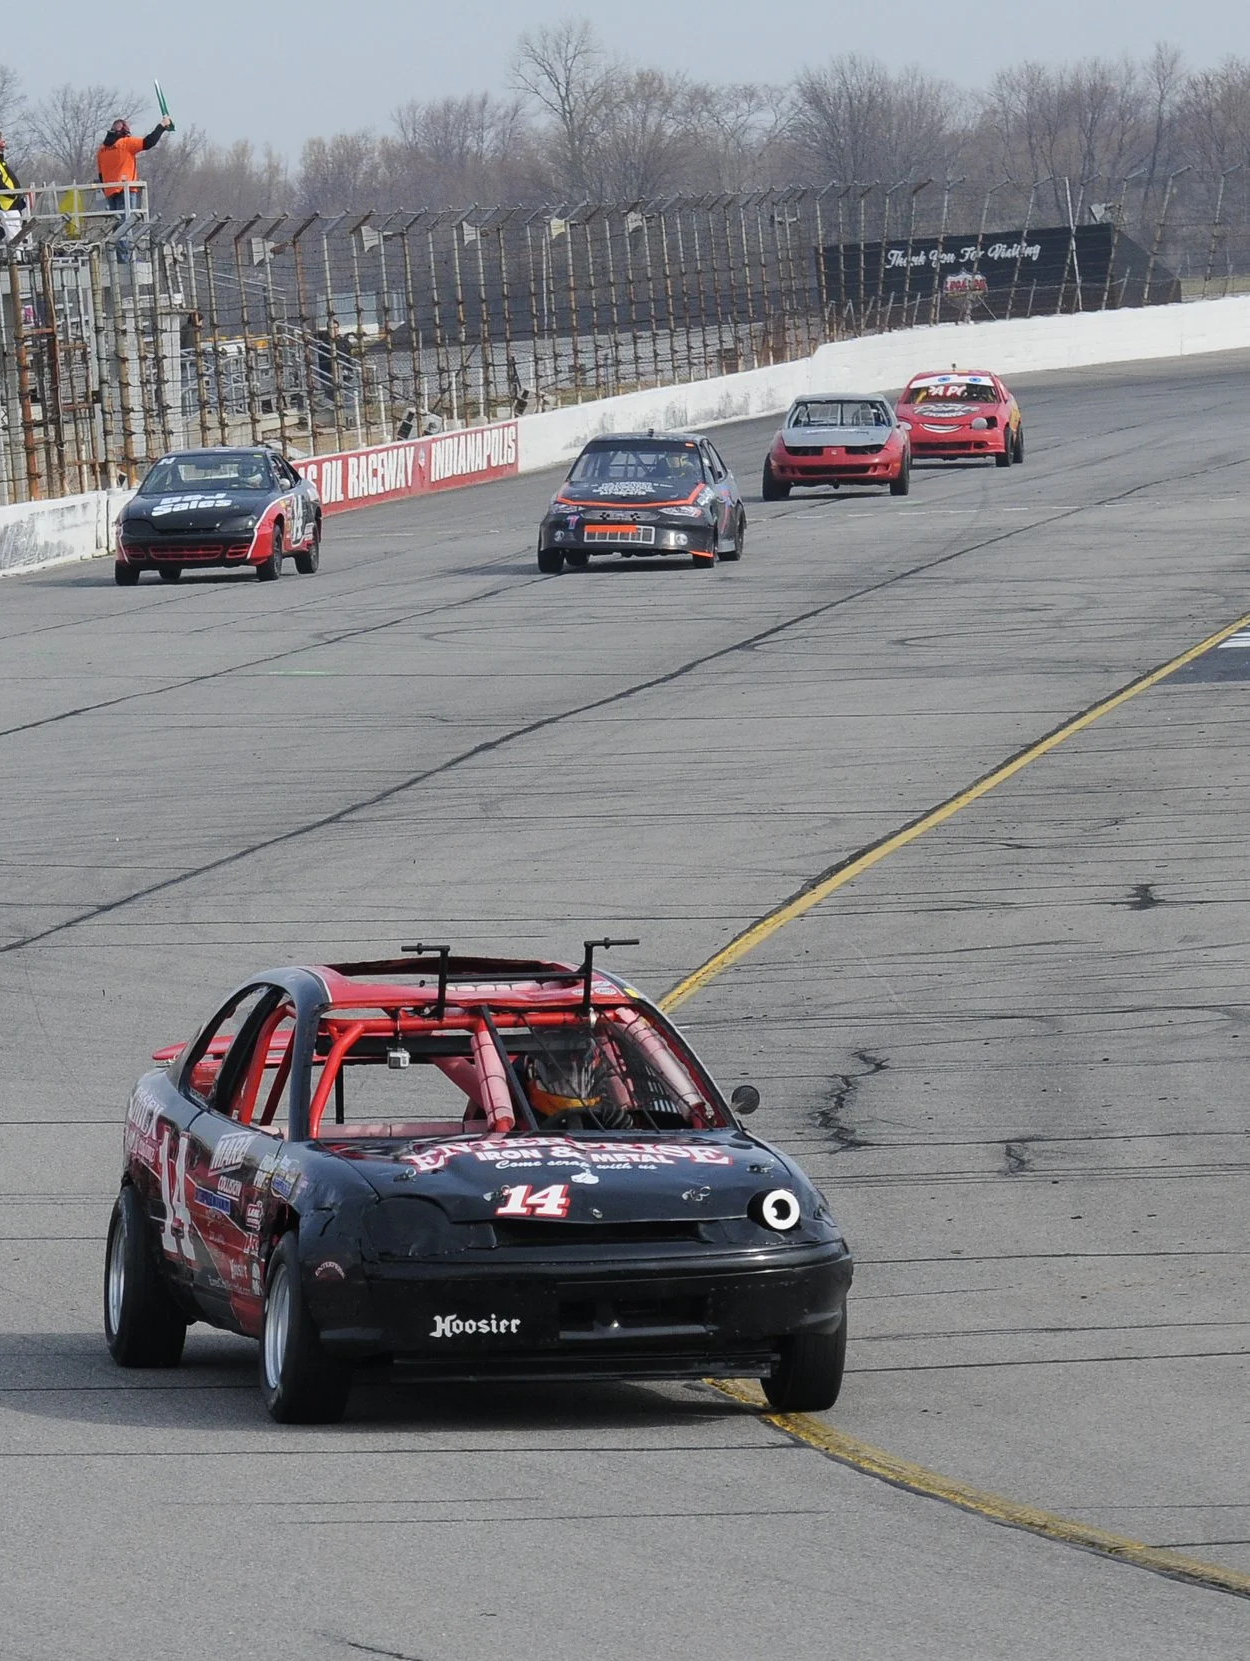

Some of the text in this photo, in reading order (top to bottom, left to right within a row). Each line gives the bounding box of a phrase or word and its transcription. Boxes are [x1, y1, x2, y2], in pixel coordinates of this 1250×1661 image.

[884, 249, 927, 269] Thank
[928, 249, 956, 268] You
[958, 245, 986, 263] For
[321, 459, 344, 504] OIL
[348, 446, 415, 499] RACEWAY
[431, 426, 517, 483] INDIANAPOLIS
[151, 499, 233, 517] Sales
[405, 1137, 733, 1171] ENTERPRISE
[477, 1146, 676, 1165] IRON & METAL
[495, 1159, 543, 1170] Come
[546, 1159, 591, 1170] scrap
[158, 1126, 196, 1262] 14
[495, 1183, 570, 1217] 14
[429, 1313, 521, 1338] Hoosier
